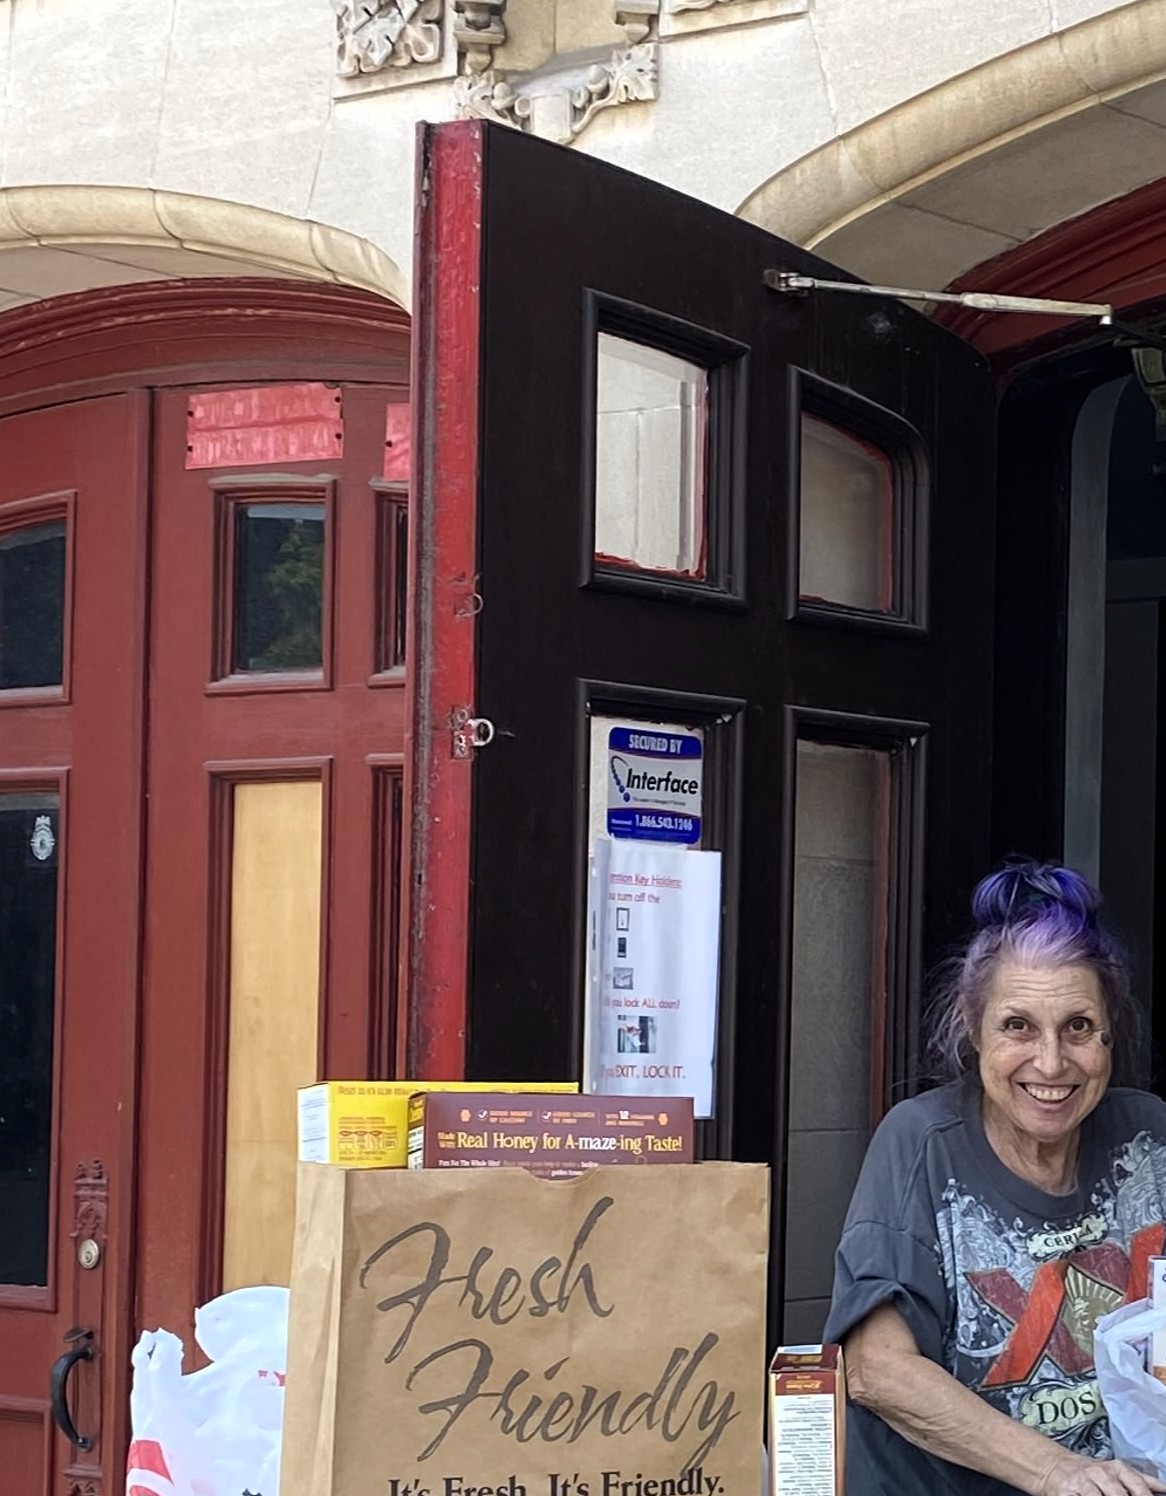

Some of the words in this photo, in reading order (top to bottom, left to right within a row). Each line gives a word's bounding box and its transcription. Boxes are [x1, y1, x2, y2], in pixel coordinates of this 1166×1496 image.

[628, 734, 669, 752] SECURED
[669, 739, 683, 754] BY
[626, 768, 699, 795] Interface
[643, 1065, 671, 1079] LOCK
[457, 1131, 488, 1149] Real
[493, 1133, 538, 1154] Honey
[543, 1133, 561, 1149] for
[565, 1134, 642, 1154] A-maze-ing
[645, 1135, 683, 1151] Taste!
[359, 1196, 614, 1364] Fresh
[405, 1332, 742, 1475] Friendly
[1037, 1391, 1097, 1426] DOS
